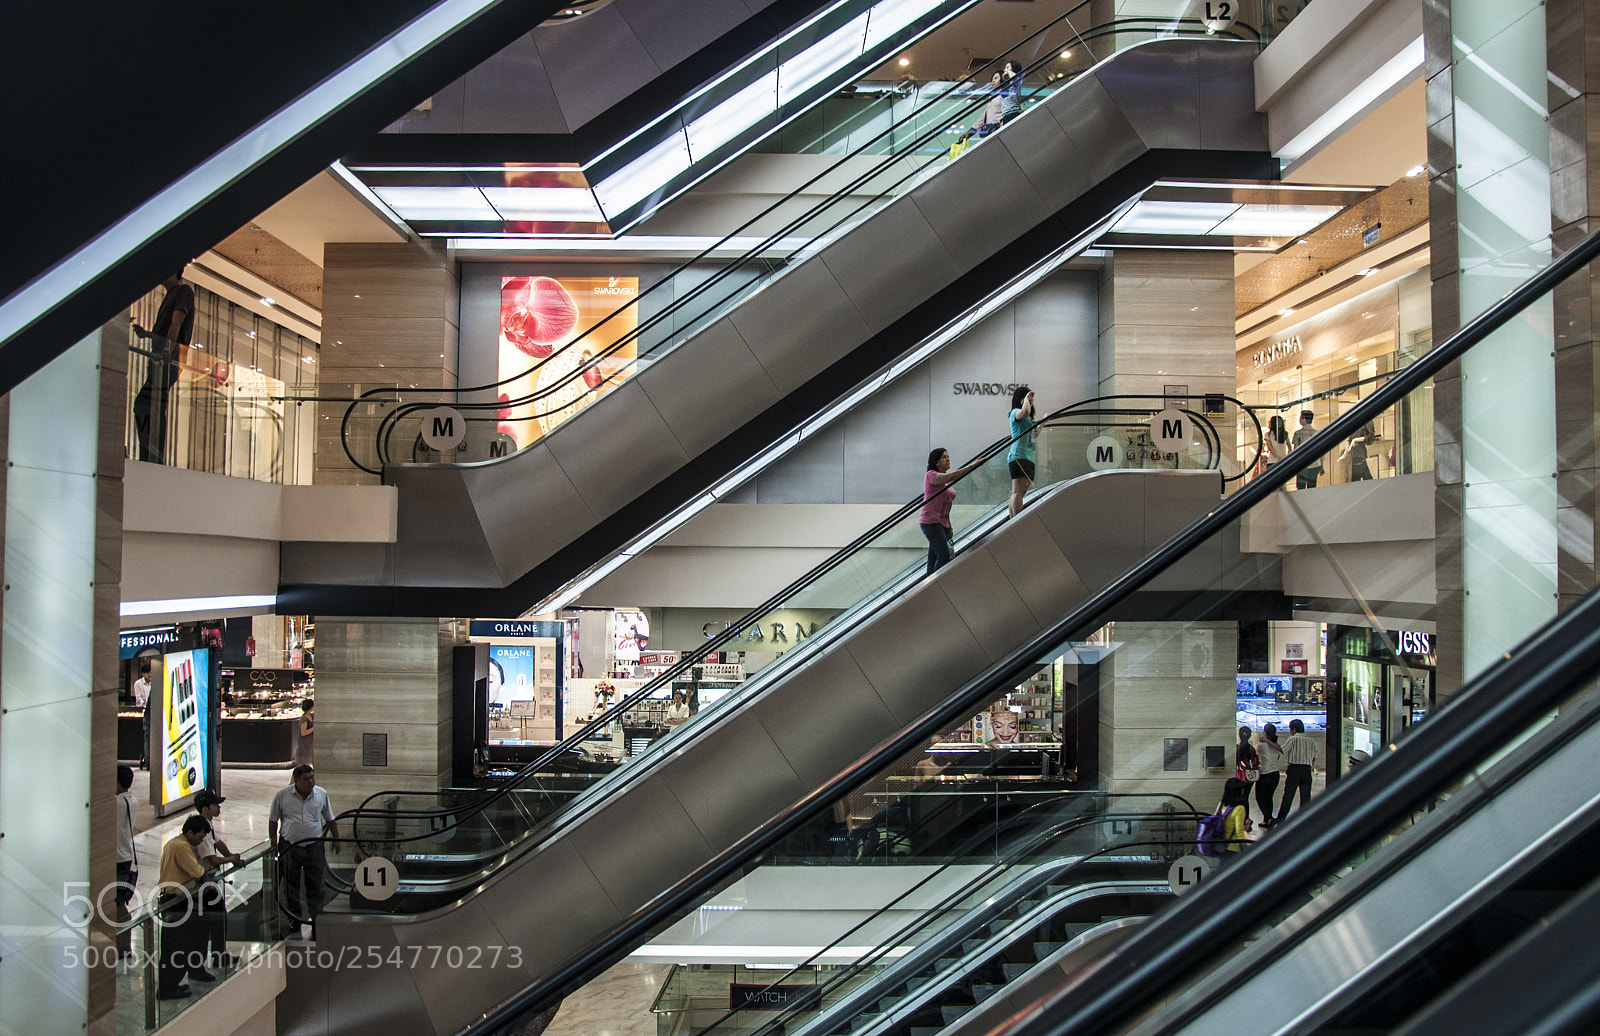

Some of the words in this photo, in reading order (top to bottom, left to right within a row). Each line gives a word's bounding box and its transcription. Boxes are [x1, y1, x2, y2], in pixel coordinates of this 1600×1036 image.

[1205, 2, 1231, 20] L2
[593, 287, 635, 295] SWAROVSKI
[953, 382, 1029, 396] SWAROVS
[432, 417, 454, 437] M
[1162, 419, 1183, 439] M
[489, 441, 508, 458] M
[1095, 446, 1114, 463] M
[494, 623, 539, 633] ORLANE
[496, 649, 531, 657] ORLANE
[249, 670, 277, 682] CAO
[1111, 820, 1132, 835] L1
[363, 866, 387, 887] L1
[1178, 866, 1202, 886] L1
[745, 991, 787, 1003] WATCH
